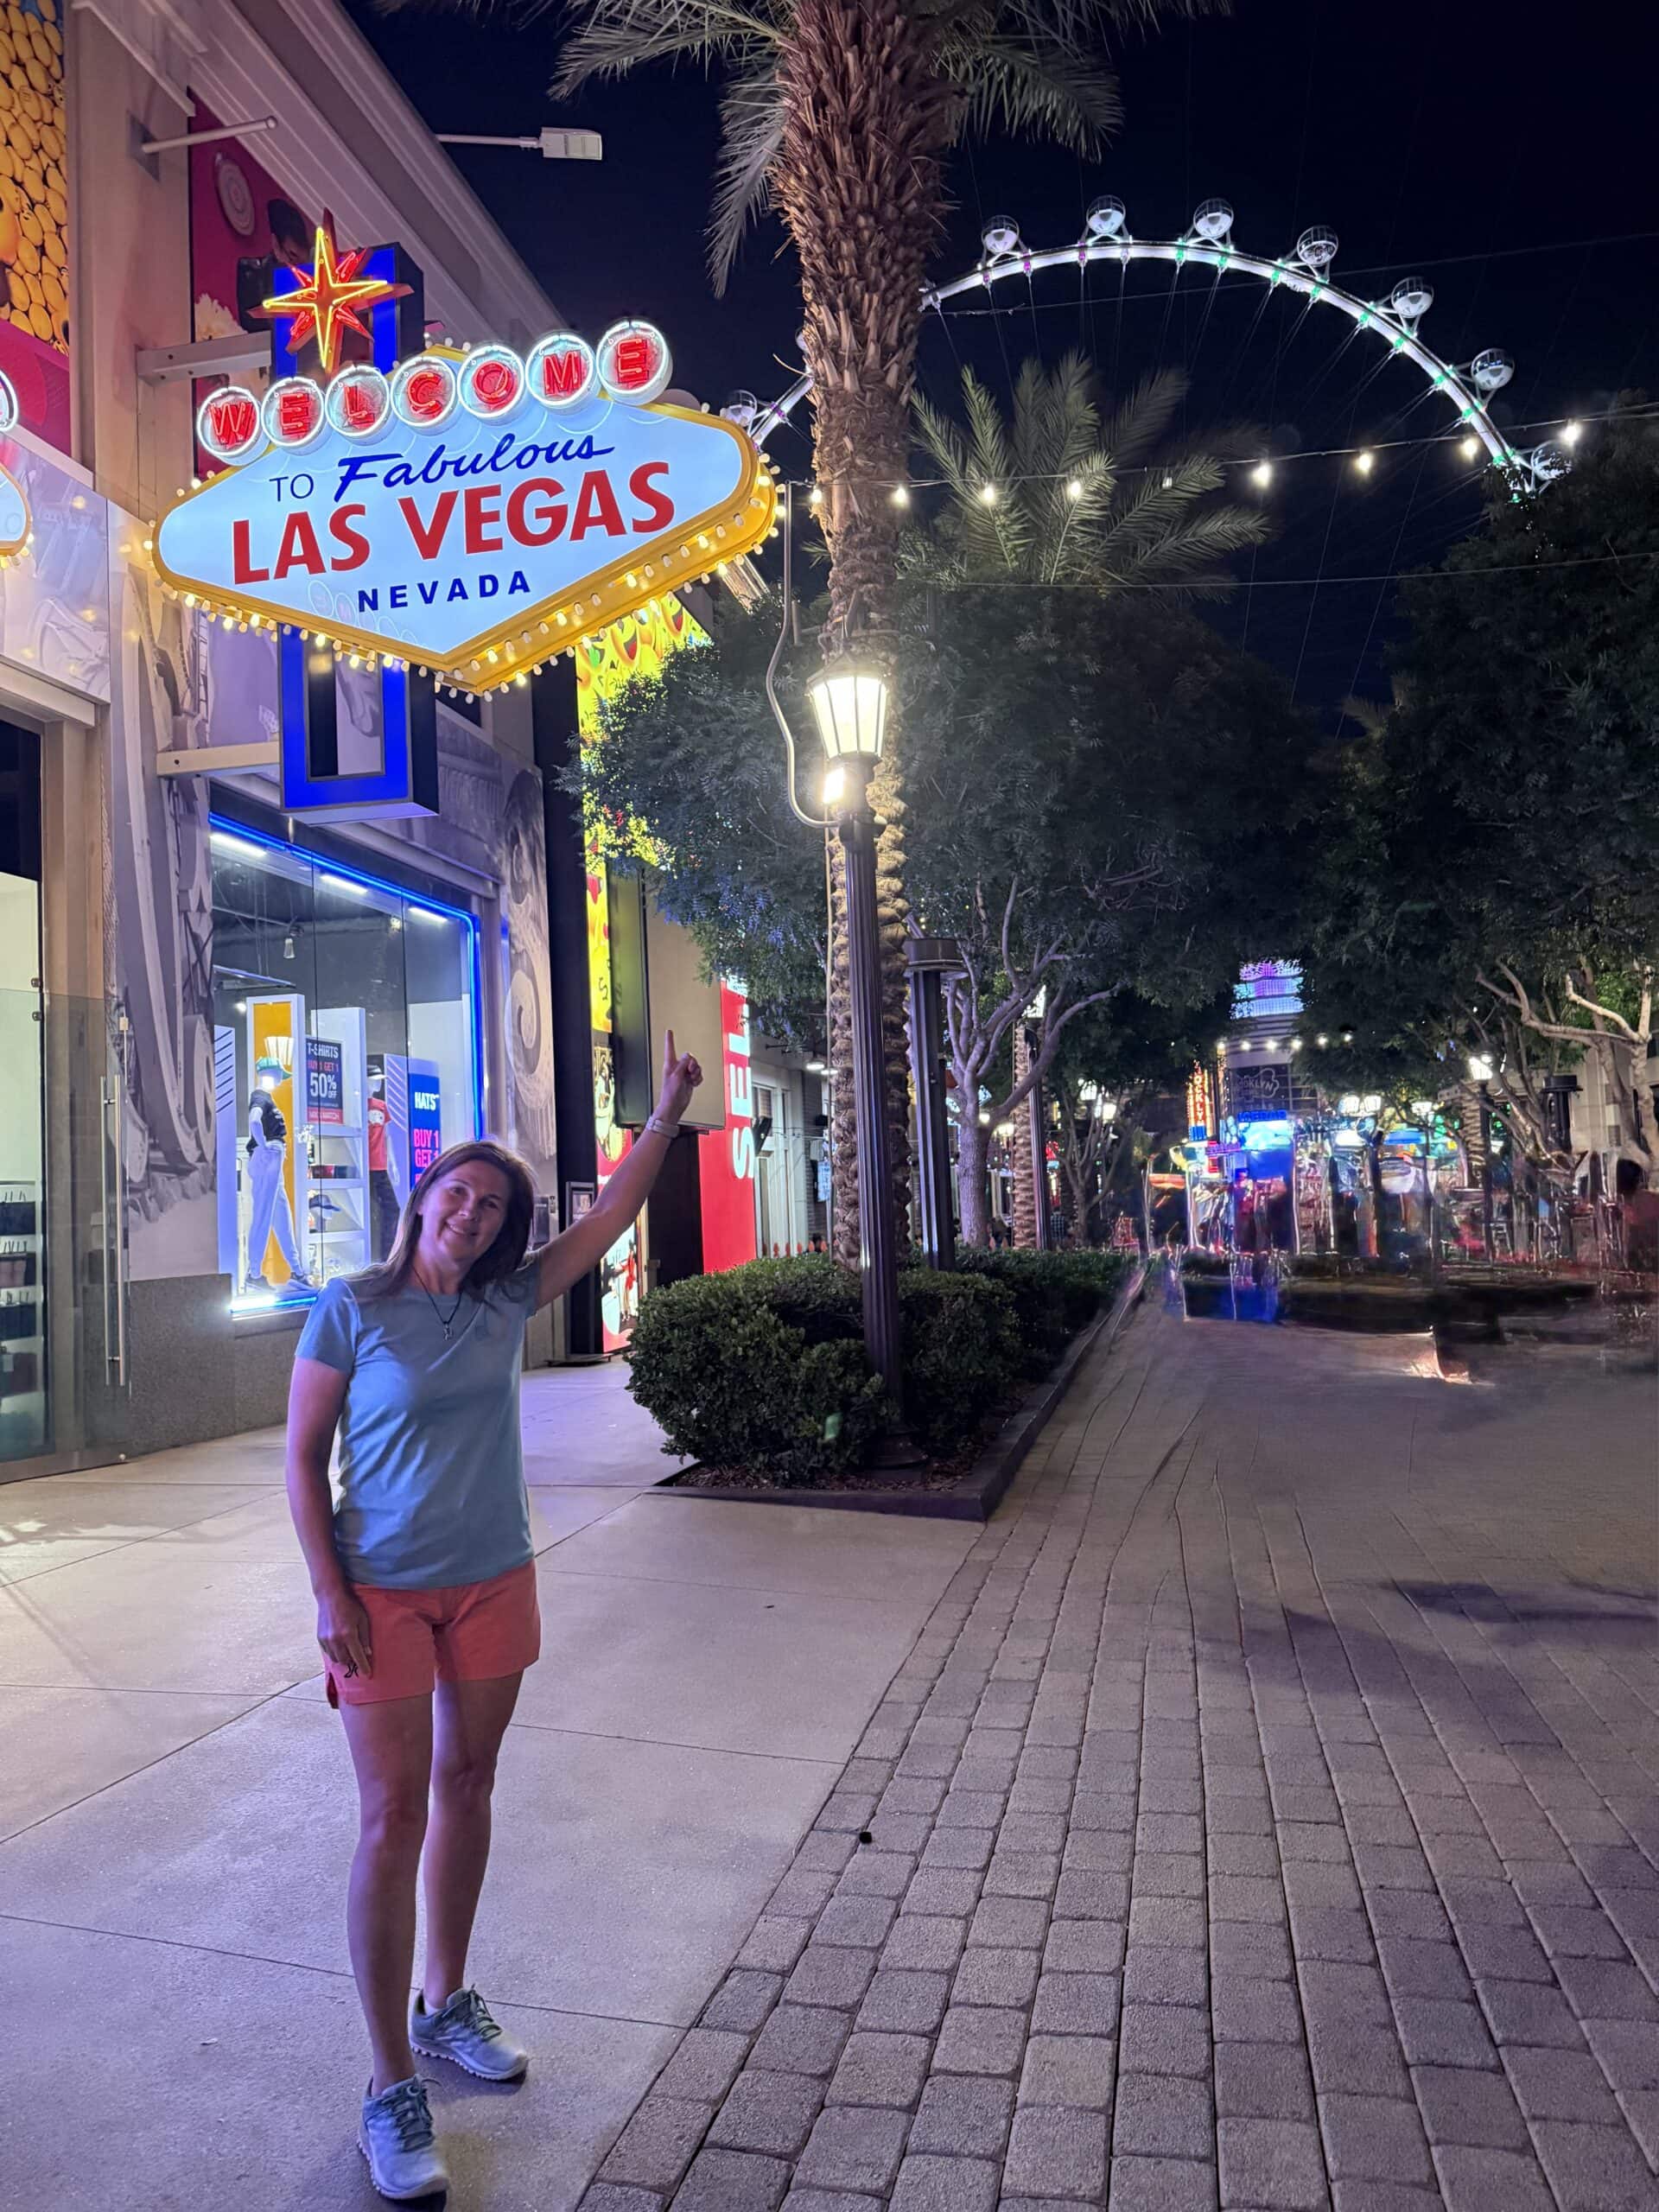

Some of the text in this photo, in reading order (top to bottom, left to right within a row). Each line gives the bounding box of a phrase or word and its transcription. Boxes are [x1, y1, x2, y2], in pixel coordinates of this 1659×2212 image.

[207, 336, 652, 449] WELCOME
[269, 433, 615, 503] TO Fabulous
[232, 461, 675, 585] LAS VEGAS
[358, 570, 531, 613] NEVADA
[309, 1071, 337, 1098] 50%
[414, 1128, 439, 1148] BUY 1
[415, 1148, 432, 1168] GET
